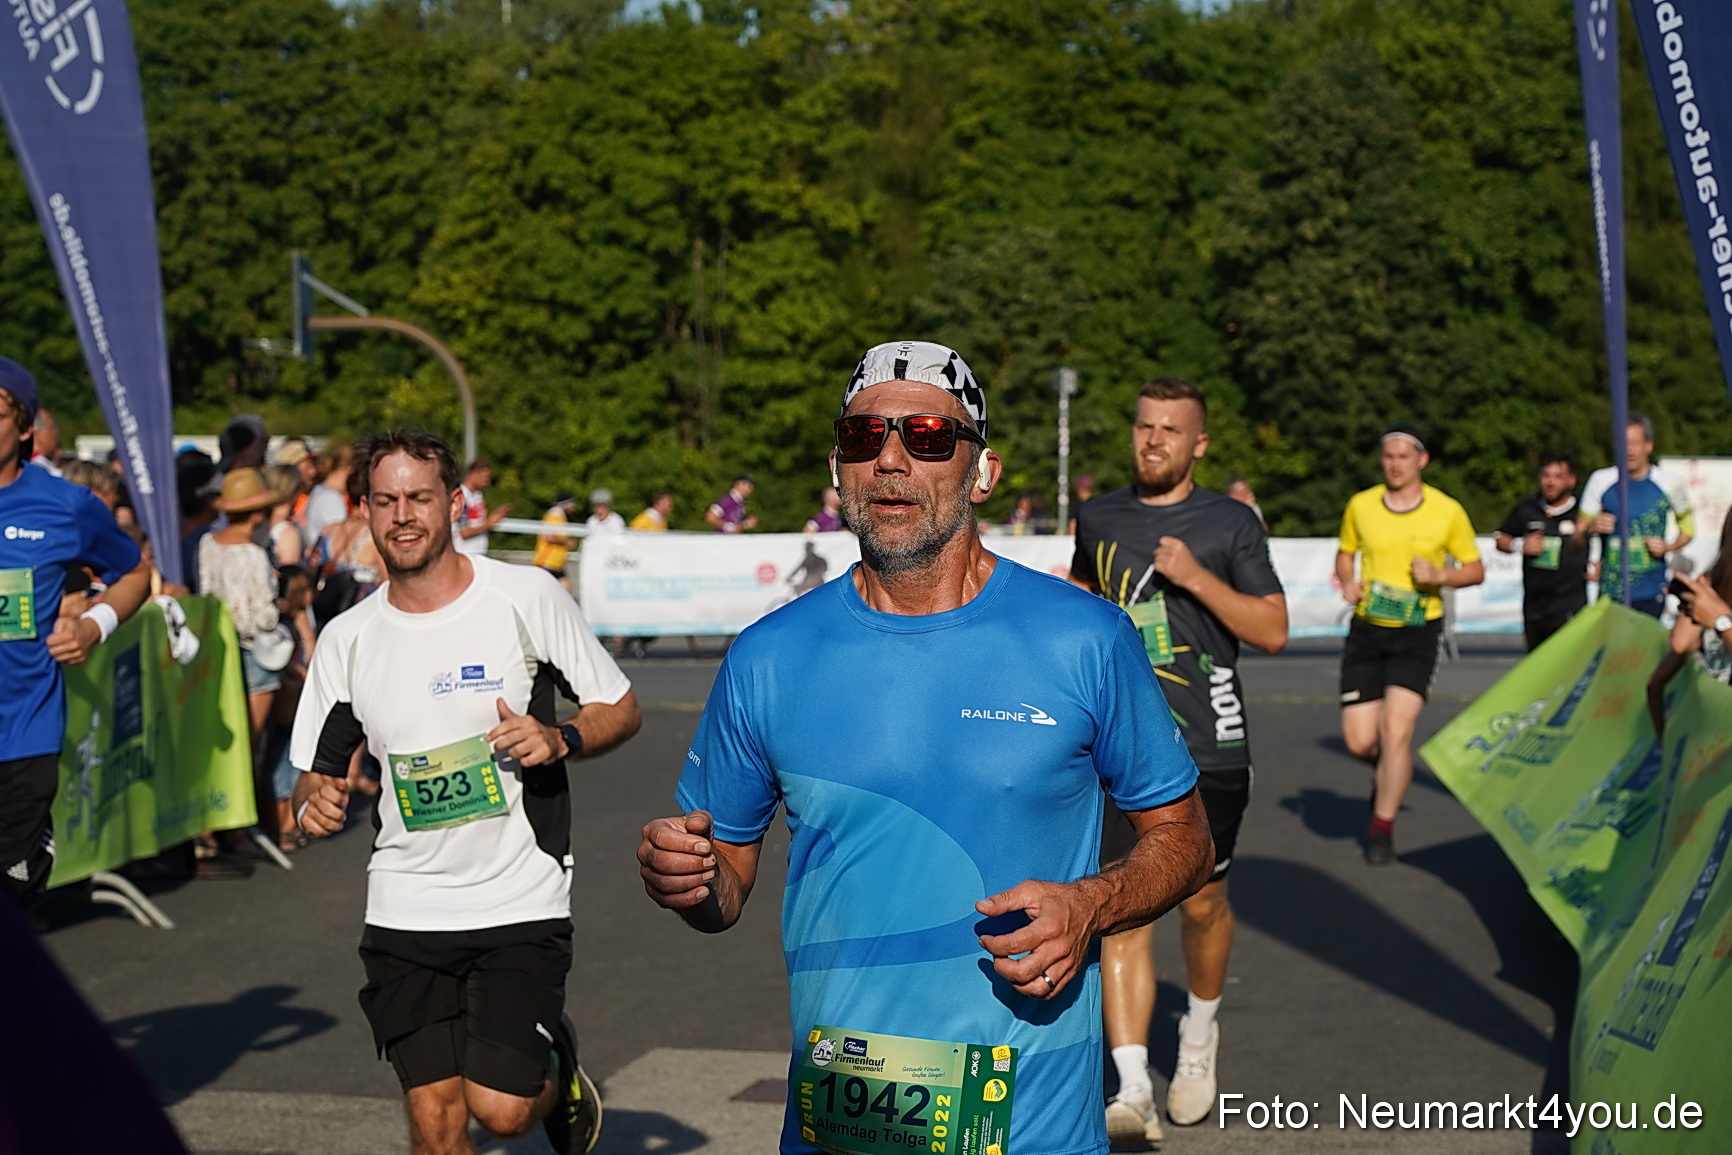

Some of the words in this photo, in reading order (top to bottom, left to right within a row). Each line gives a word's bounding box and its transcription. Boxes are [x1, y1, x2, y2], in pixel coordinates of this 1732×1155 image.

[454, 677, 504, 690] Firmenlauf
[961, 709, 1027, 722] RAILONE
[415, 770, 472, 805] 523
[481, 765, 501, 804] 2022
[398, 789, 413, 817] RUN
[411, 803, 447, 817] Wiesner
[835, 1053, 886, 1067] Firmenlauf
[852, 1065, 883, 1073] neumarkt
[971, 1060, 979, 1077] AOK
[801, 1082, 814, 1125] RUN
[819, 1072, 931, 1127] 1942
[816, 1116, 877, 1143] Alemdag
[883, 1128, 927, 1148] Tolga
[931, 1094, 951, 1153] 2022
